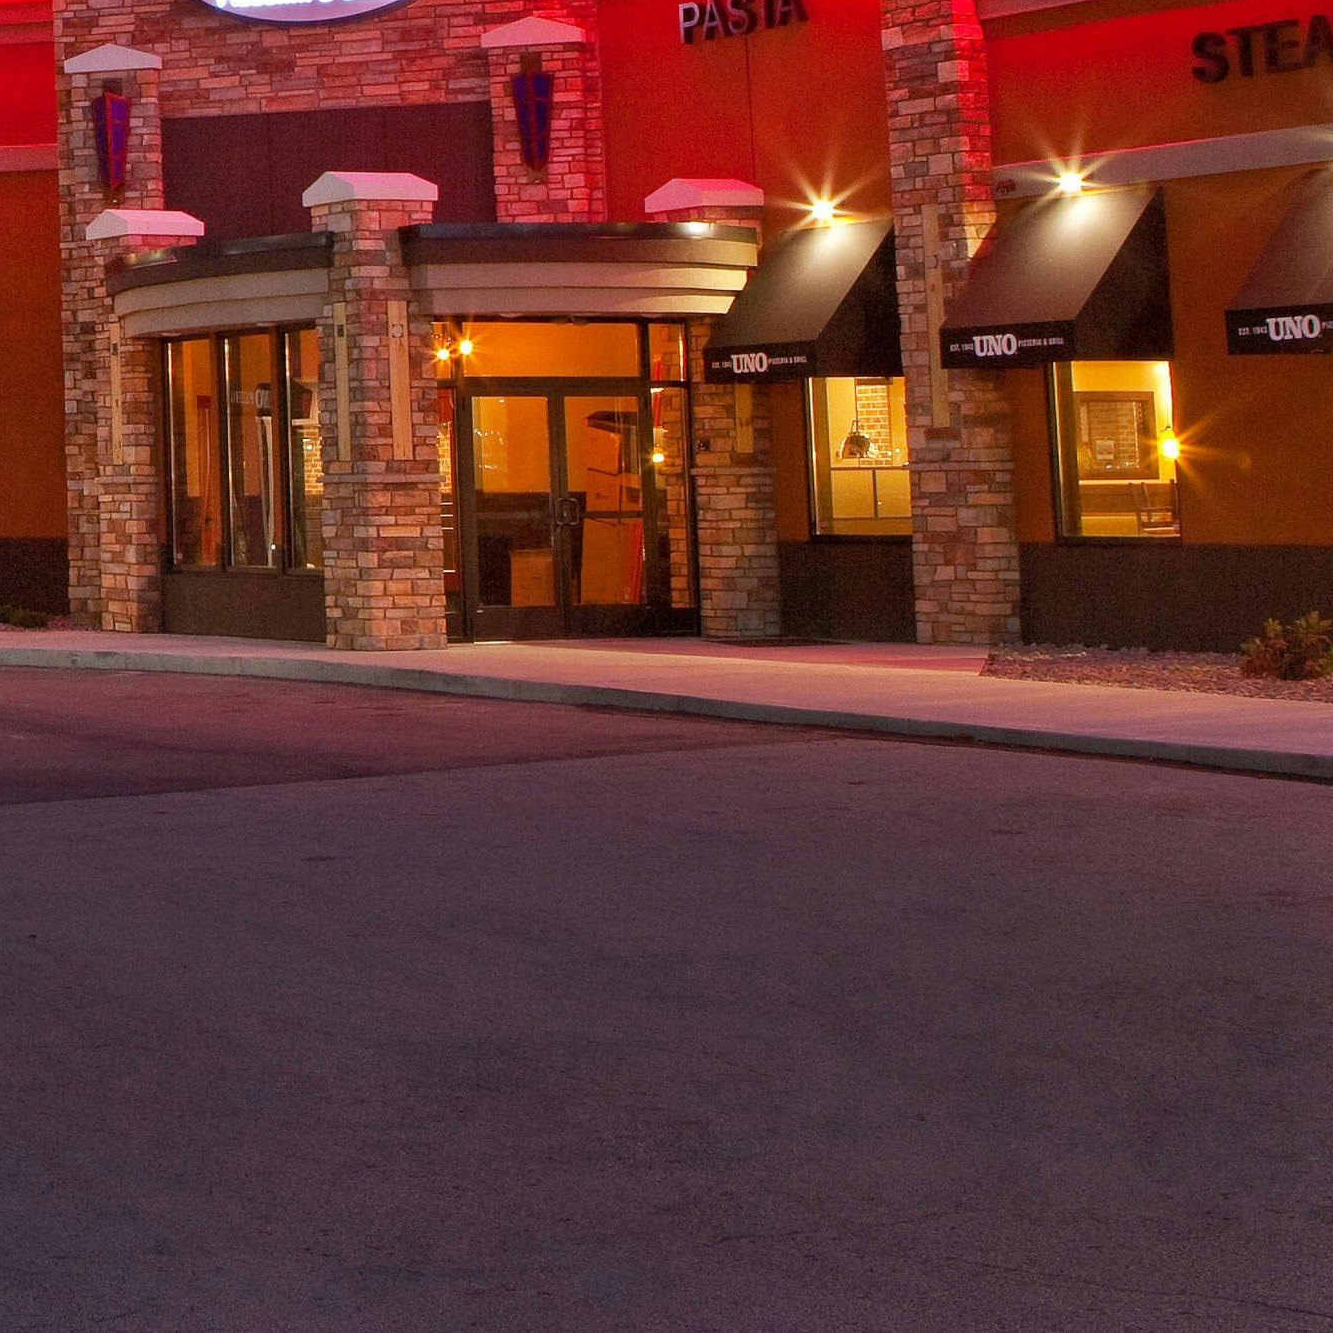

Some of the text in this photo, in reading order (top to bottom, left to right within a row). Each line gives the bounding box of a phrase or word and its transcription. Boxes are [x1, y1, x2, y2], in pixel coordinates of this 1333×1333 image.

[1266, 314, 1321, 341] UNO
[972, 333, 1017, 357] UNO
[731, 352, 768, 374] UNO
